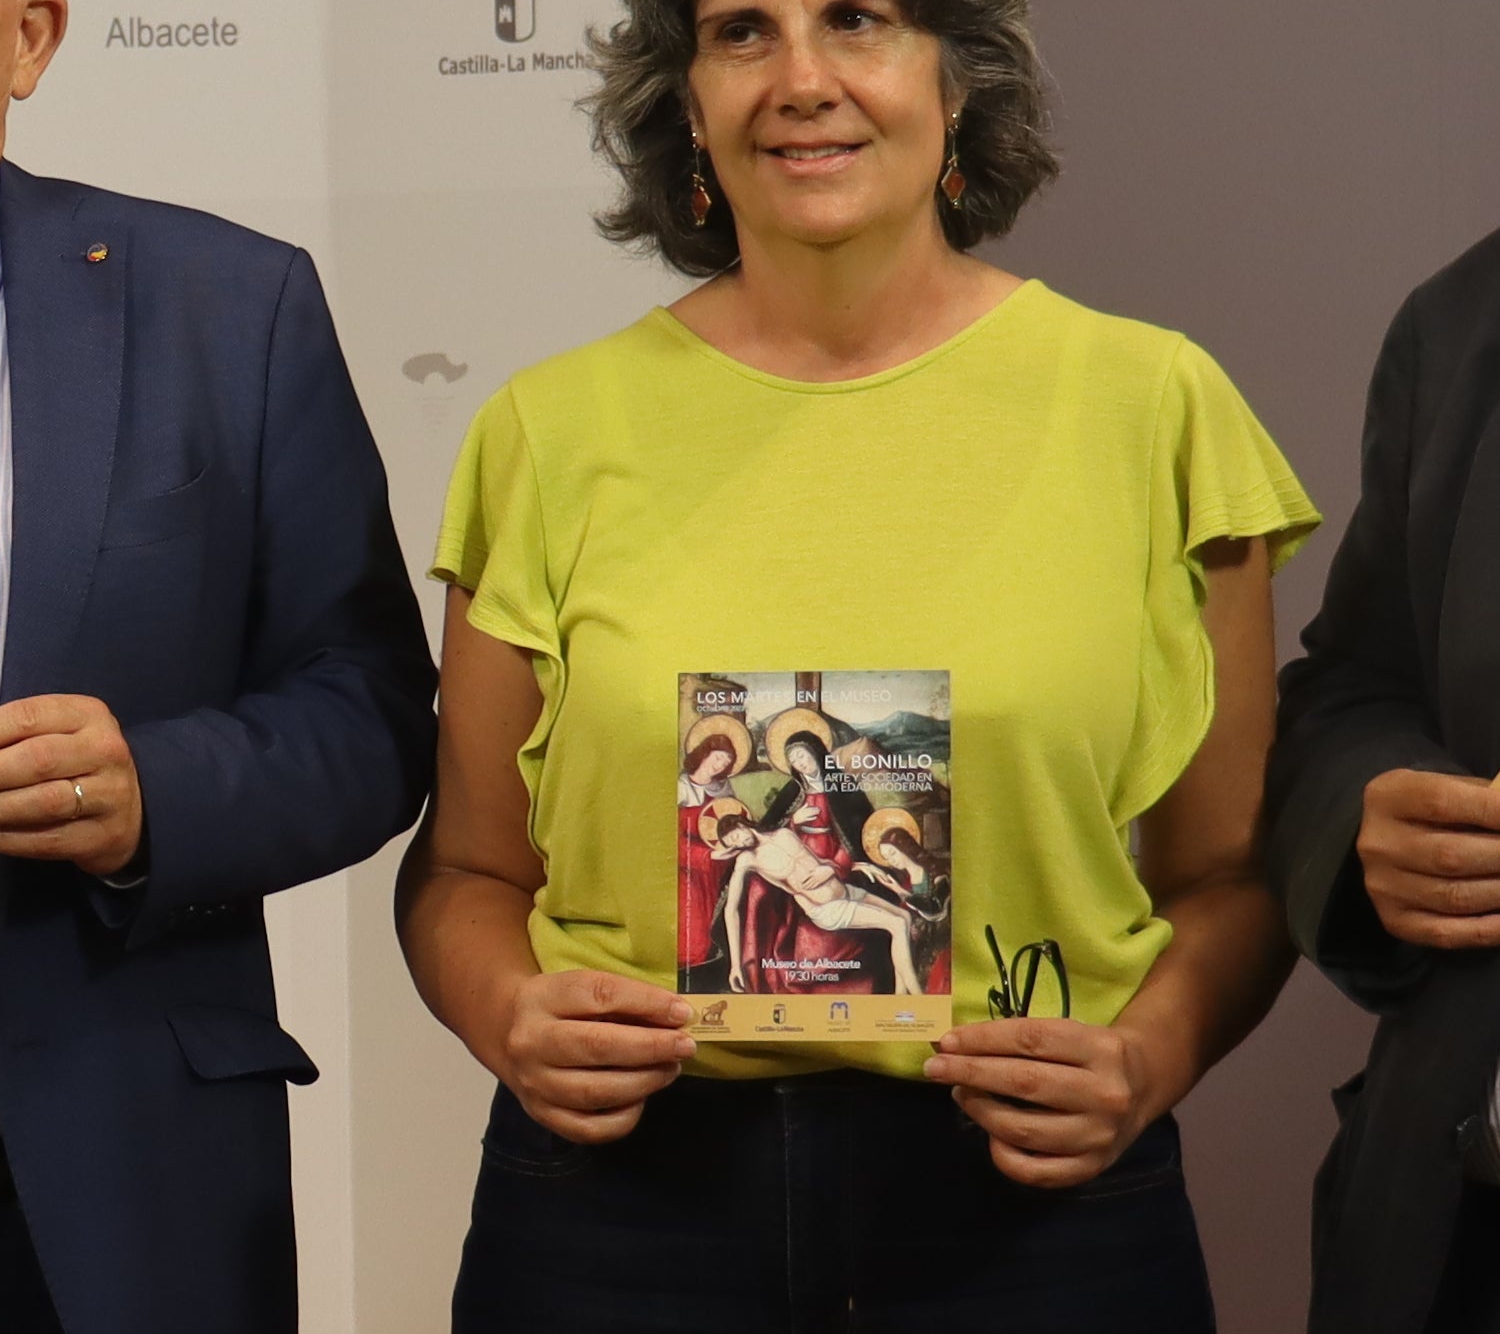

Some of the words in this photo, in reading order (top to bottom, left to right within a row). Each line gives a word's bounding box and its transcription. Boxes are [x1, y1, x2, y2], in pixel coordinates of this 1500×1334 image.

[104, 16, 240, 50] Albacete
[438, 53, 526, 76] Castilla-La
[696, 691, 726, 704] LOS
[796, 690, 817, 703] EN
[839, 689, 892, 703] MUSEO
[824, 754, 846, 769] EL
[851, 753, 933, 770] BONILLO
[823, 772, 851, 783] ARTE
[850, 772, 859, 782] Y
[861, 772, 916, 782] SOCIEDAD
[916, 772, 933, 782] EN
[824, 782, 839, 793] LA
[840, 782, 872, 793] EDAD
[874, 782, 934, 792] MODERNA
[761, 957, 797, 970] Museo
[798, 958, 815, 969] de
[815, 957, 862, 970] Albacete
[811, 970, 840, 982] horas
